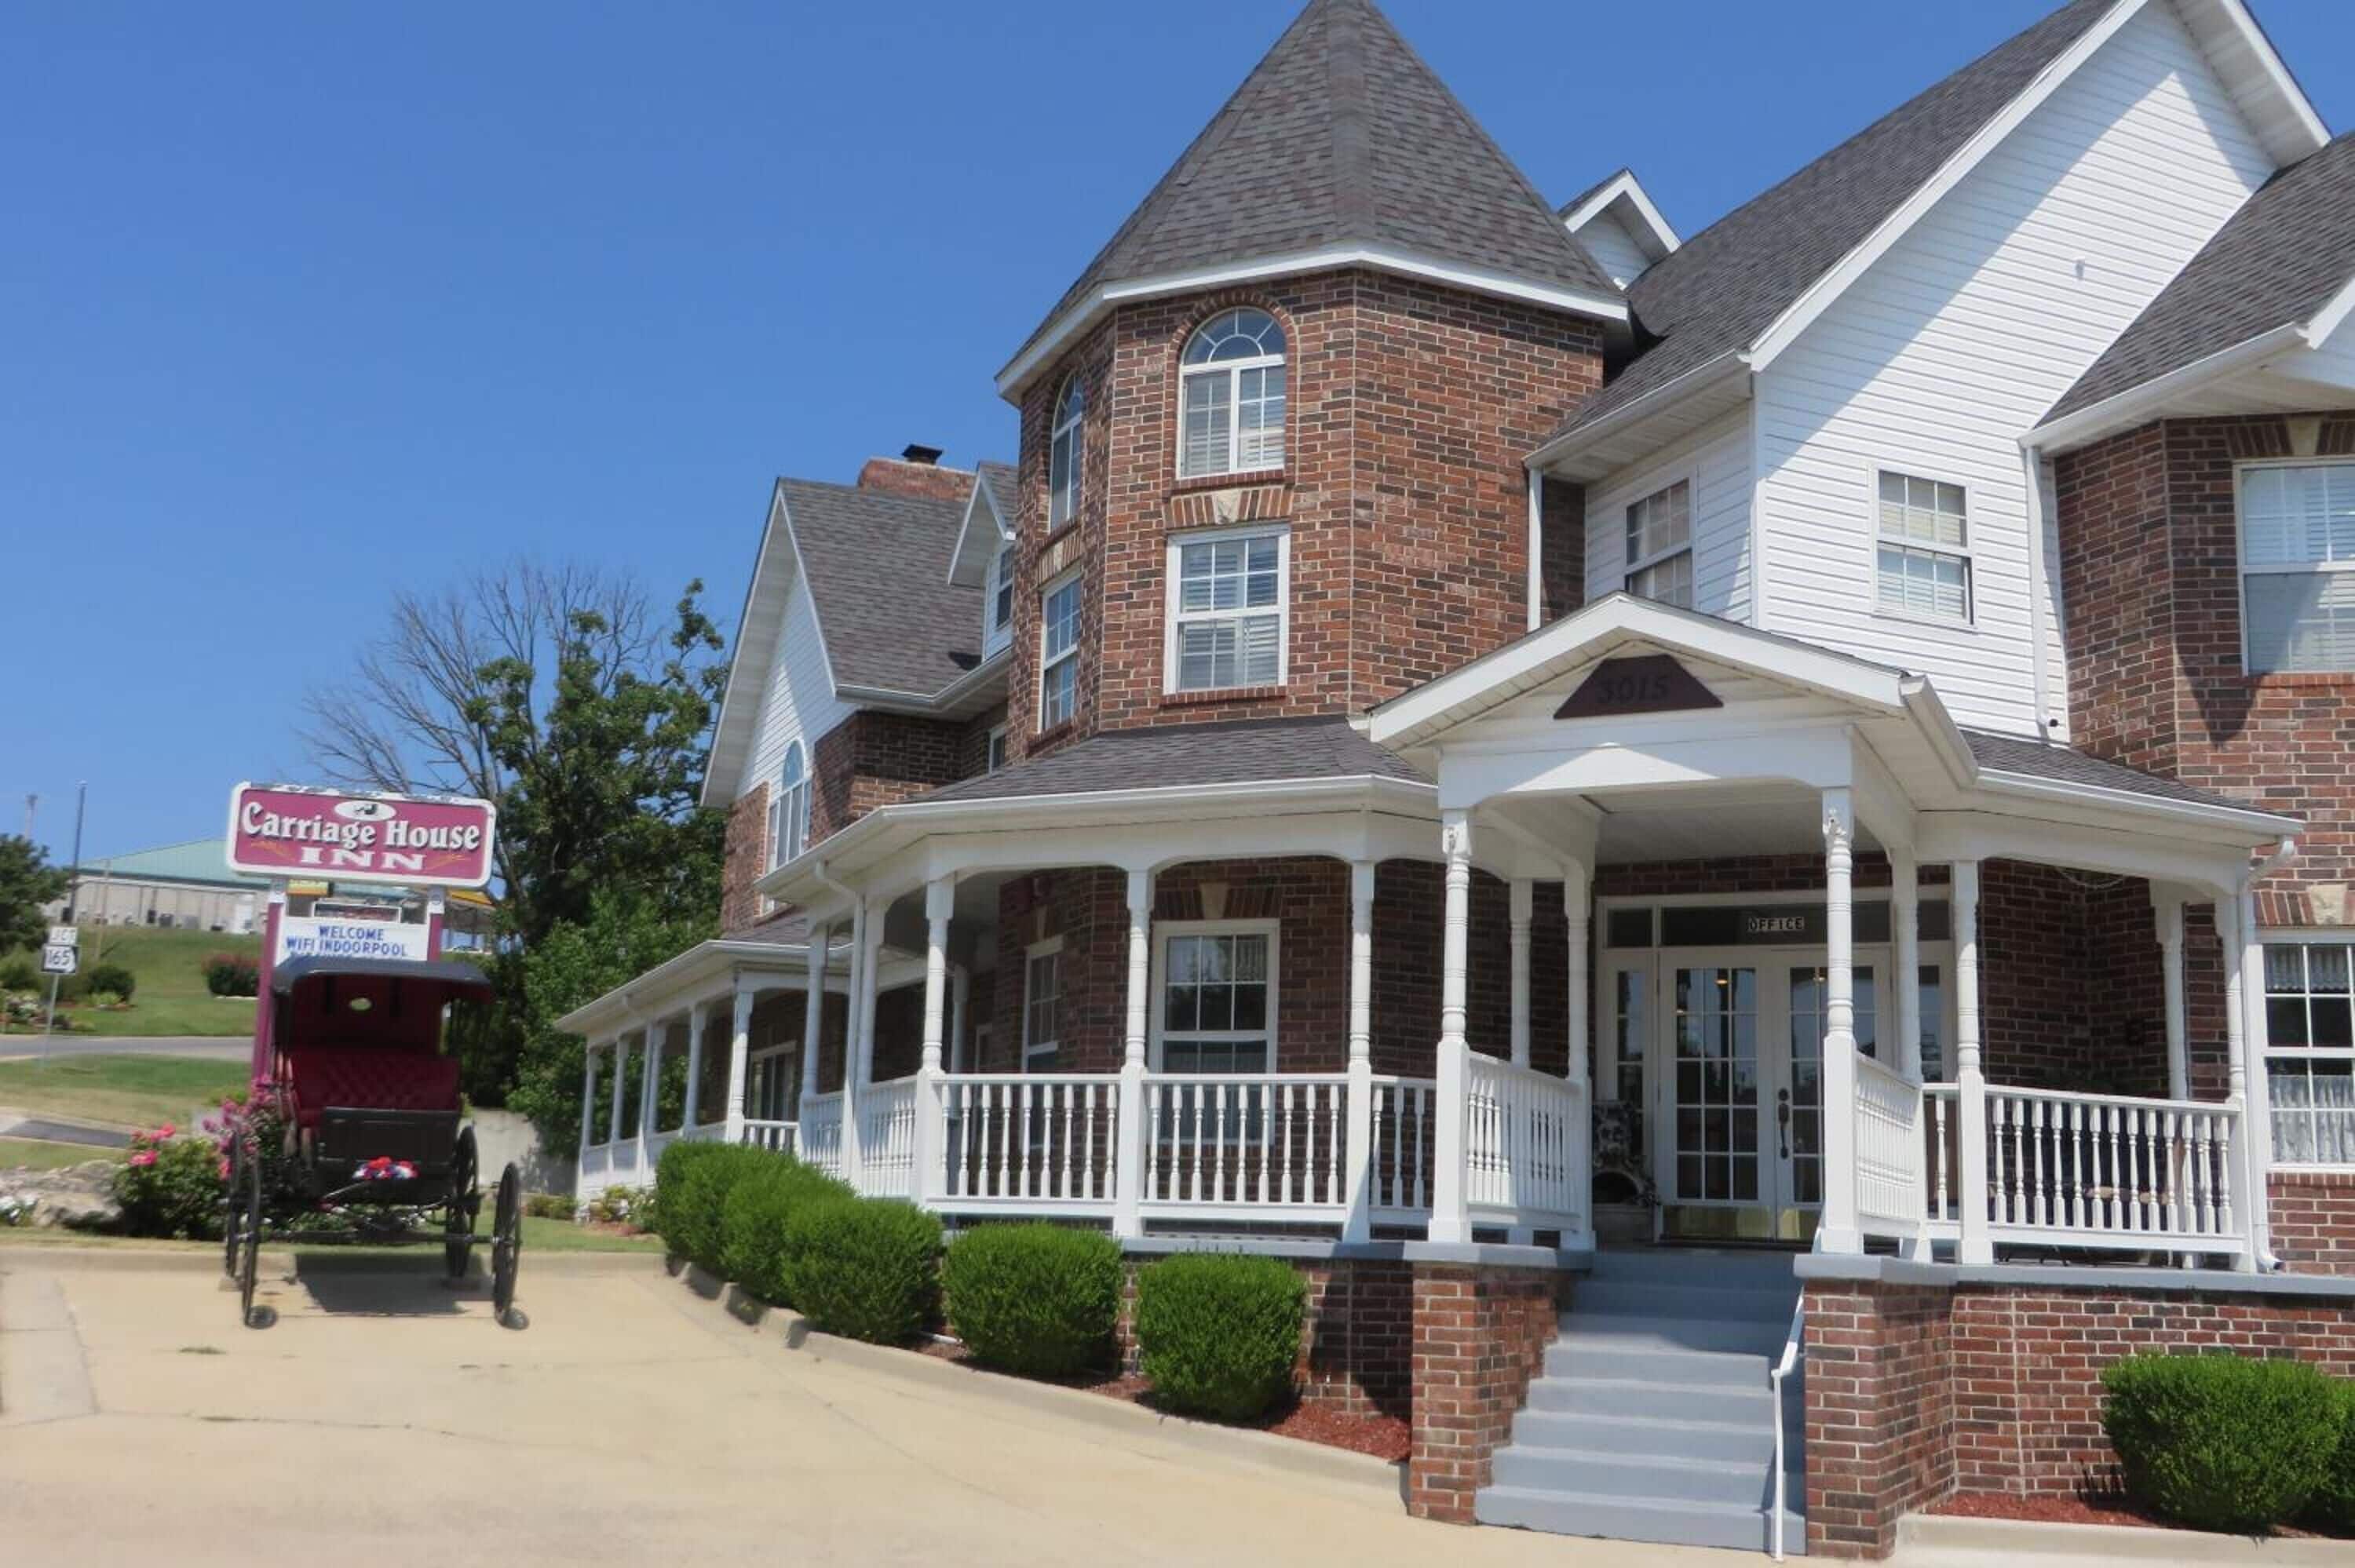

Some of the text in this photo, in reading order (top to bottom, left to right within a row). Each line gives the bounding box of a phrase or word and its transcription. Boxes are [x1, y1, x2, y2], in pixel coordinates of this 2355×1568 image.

[1597, 675, 1671, 705] 3015
[242, 801, 480, 850] Carriage House
[301, 847, 426, 870] INN
[1748, 917, 1804, 931] OFFICE
[319, 926, 385, 941] WELCOME
[286, 936, 314, 951] WIFI
[49, 950, 70, 965] 165
